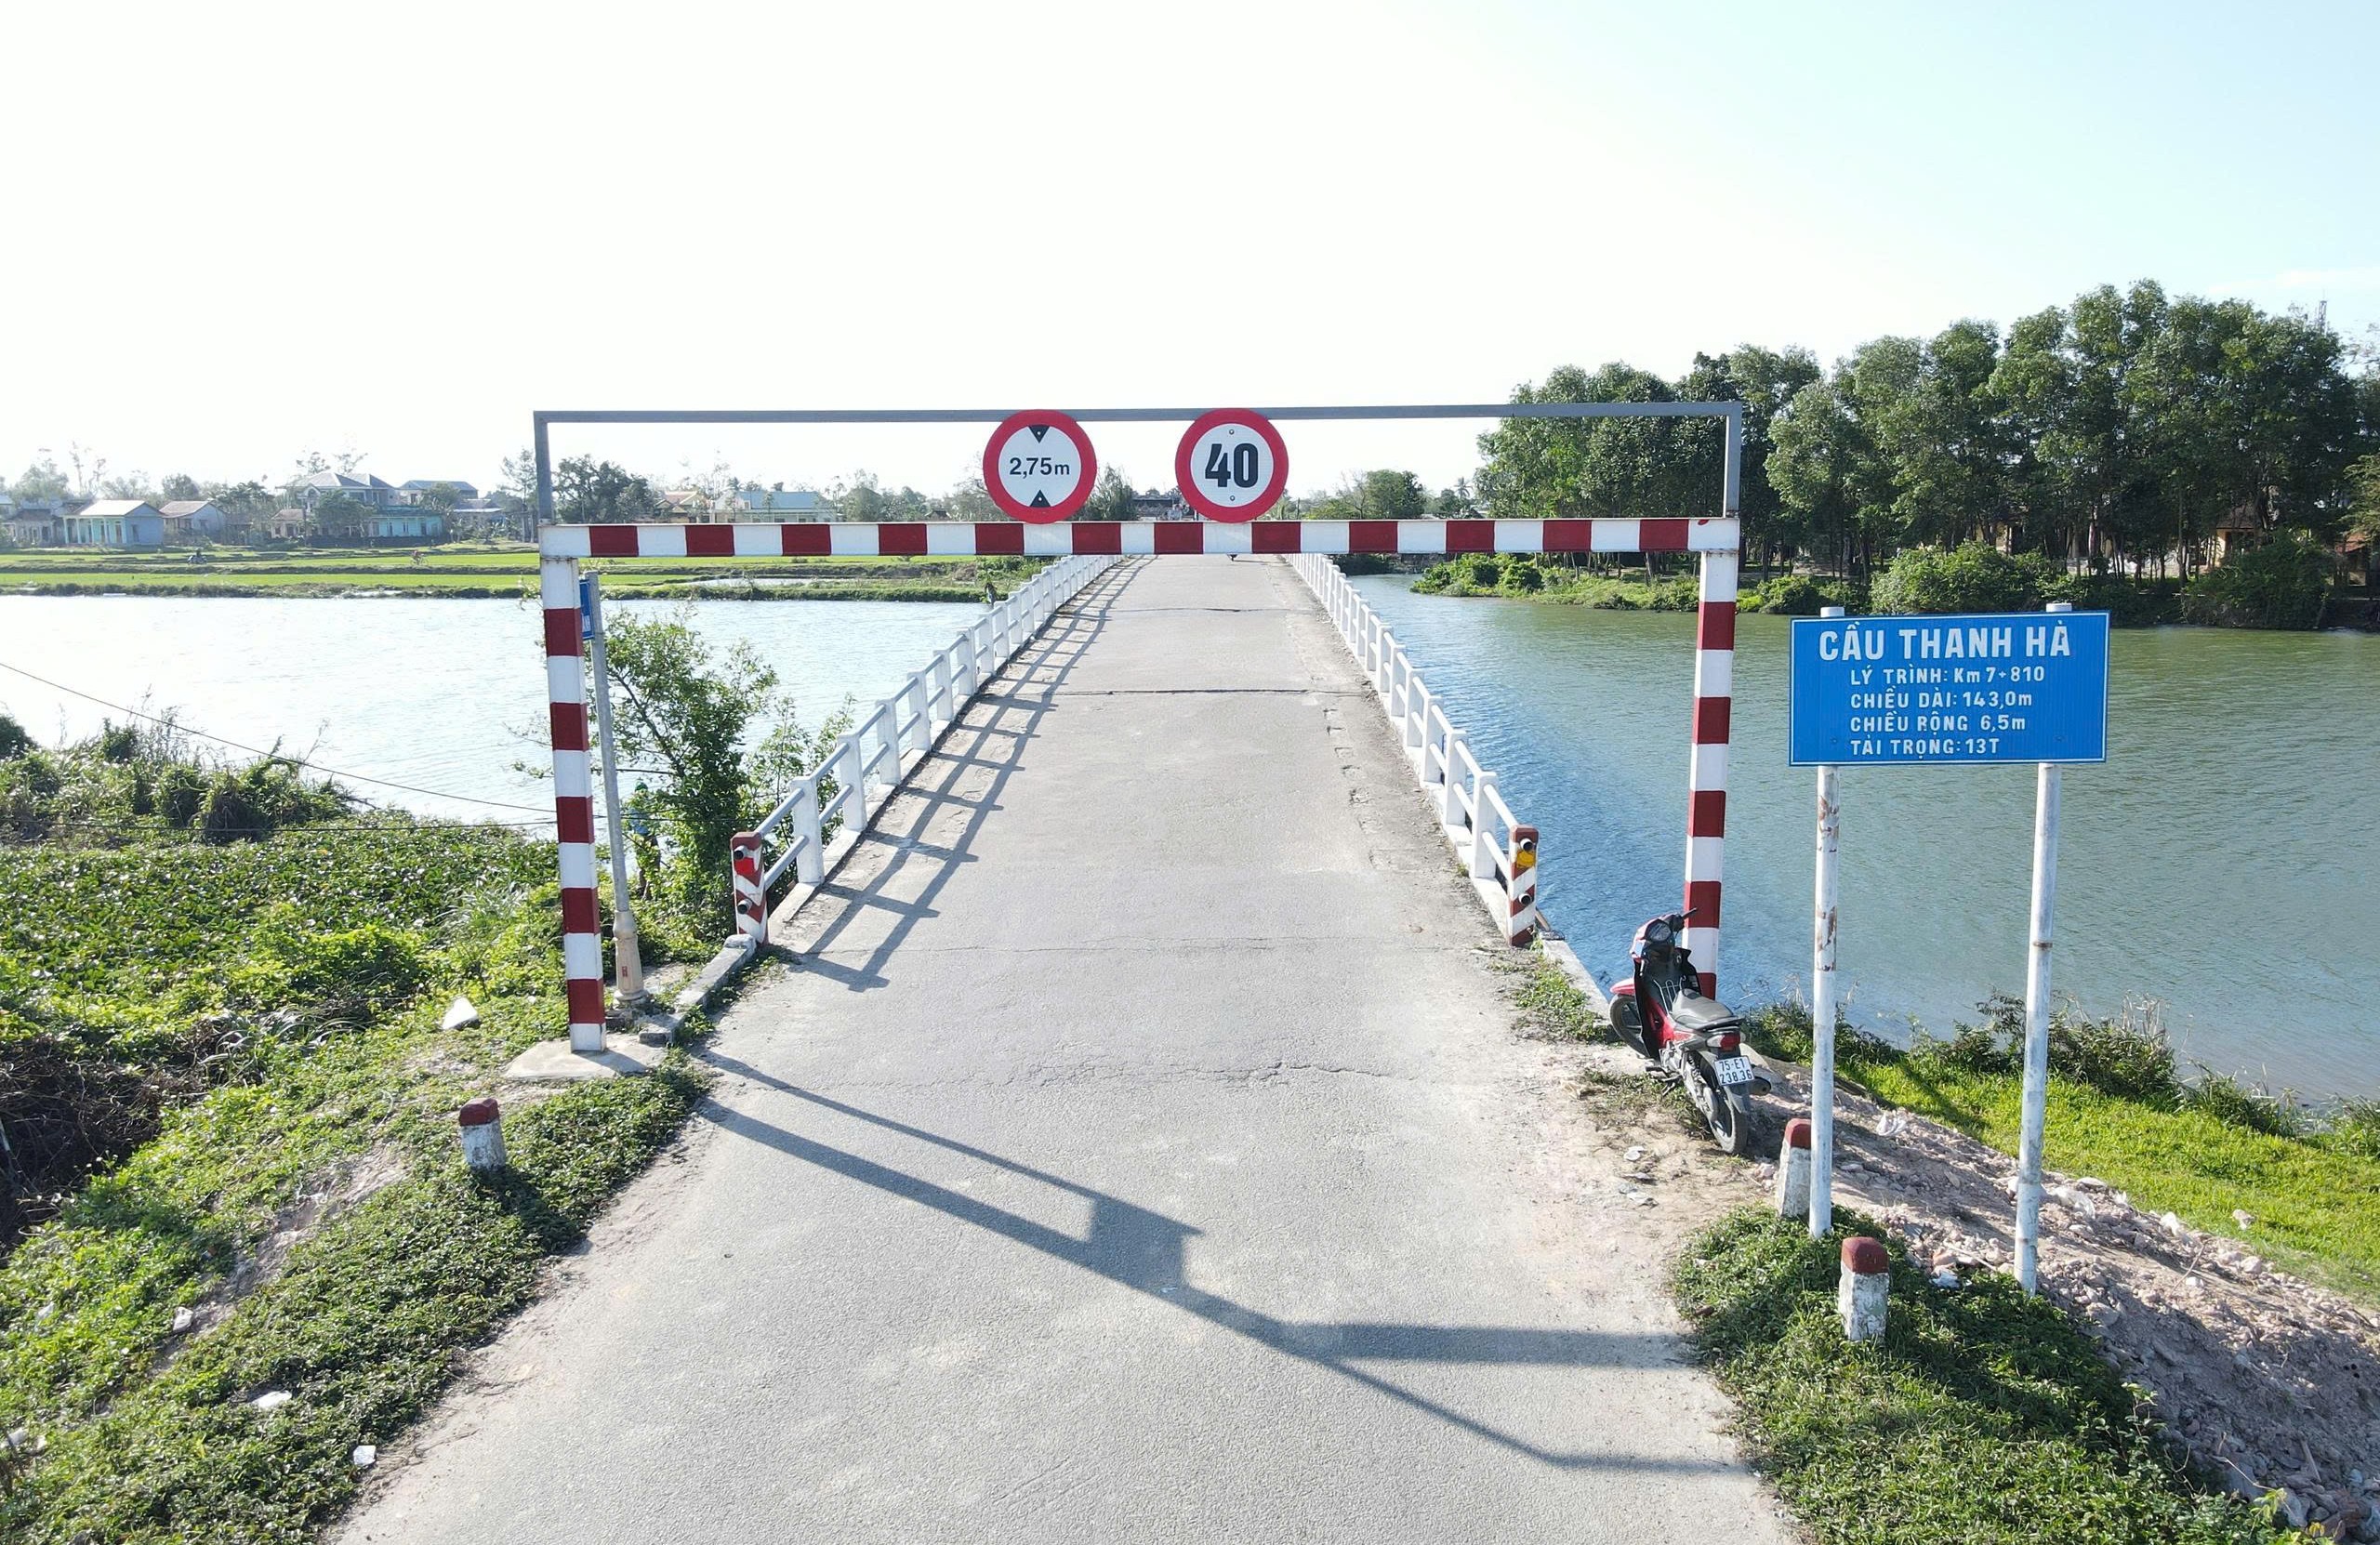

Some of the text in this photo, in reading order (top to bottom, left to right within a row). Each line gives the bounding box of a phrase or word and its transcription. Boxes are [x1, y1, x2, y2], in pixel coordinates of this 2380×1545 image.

[1009, 456, 1070, 479] 2,75m
[1205, 442, 1259, 488] 40
[1818, 619, 2070, 661] CẦU THANH HÀ
[1850, 665, 1872, 685] LÝ
[1883, 664, 1949, 684] TRÌNH:
[1850, 685, 2032, 709] CHIỀU DÀI: 143,0m
[1850, 710, 2026, 735] CHIỀU RỘNG 6,5m
[1850, 734, 2000, 759] TẢI TRỌNG: 13T
